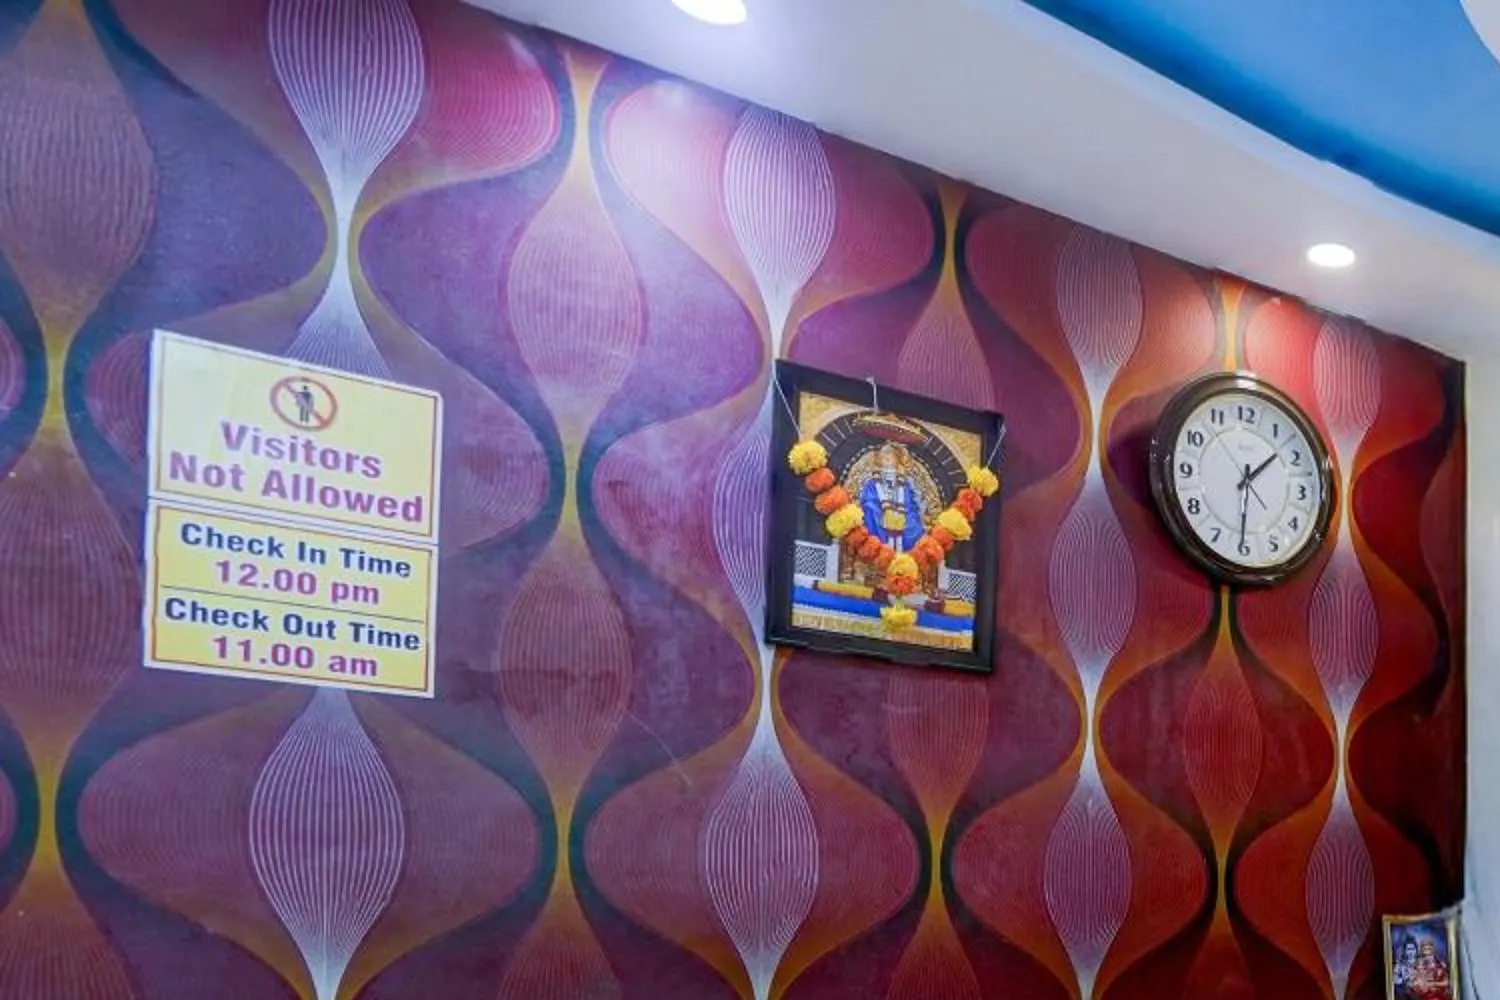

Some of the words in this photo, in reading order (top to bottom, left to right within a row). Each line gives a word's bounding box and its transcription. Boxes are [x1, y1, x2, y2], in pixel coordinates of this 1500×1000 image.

[1211, 408, 1225, 425] 11
[1237, 405, 1256, 424] 12
[1187, 430, 1204, 446] 10
[220, 421, 381, 479] Visitors
[1290, 450, 1301, 466] 2
[1179, 463, 1193, 478] 9
[169, 451, 245, 492] Not
[261, 469, 423, 522] Allowed
[1298, 485, 1307, 501] 3
[1187, 498, 1200, 515] 8
[1288, 516, 1299, 531] 4
[1209, 527, 1221, 542] 7
[181, 523, 284, 560] Check
[298, 541, 326, 565] In
[339, 547, 411, 578] Time
[1237, 540, 1250, 556] 6
[1269, 535, 1279, 552] 5
[216, 560, 317, 595] 12.00
[330, 580, 380, 605] pm
[165, 597, 269, 632] Check
[283, 614, 336, 641] Out
[350, 622, 421, 651] Time
[213, 635, 314, 669] 11.00
[328, 654, 378, 677] am
